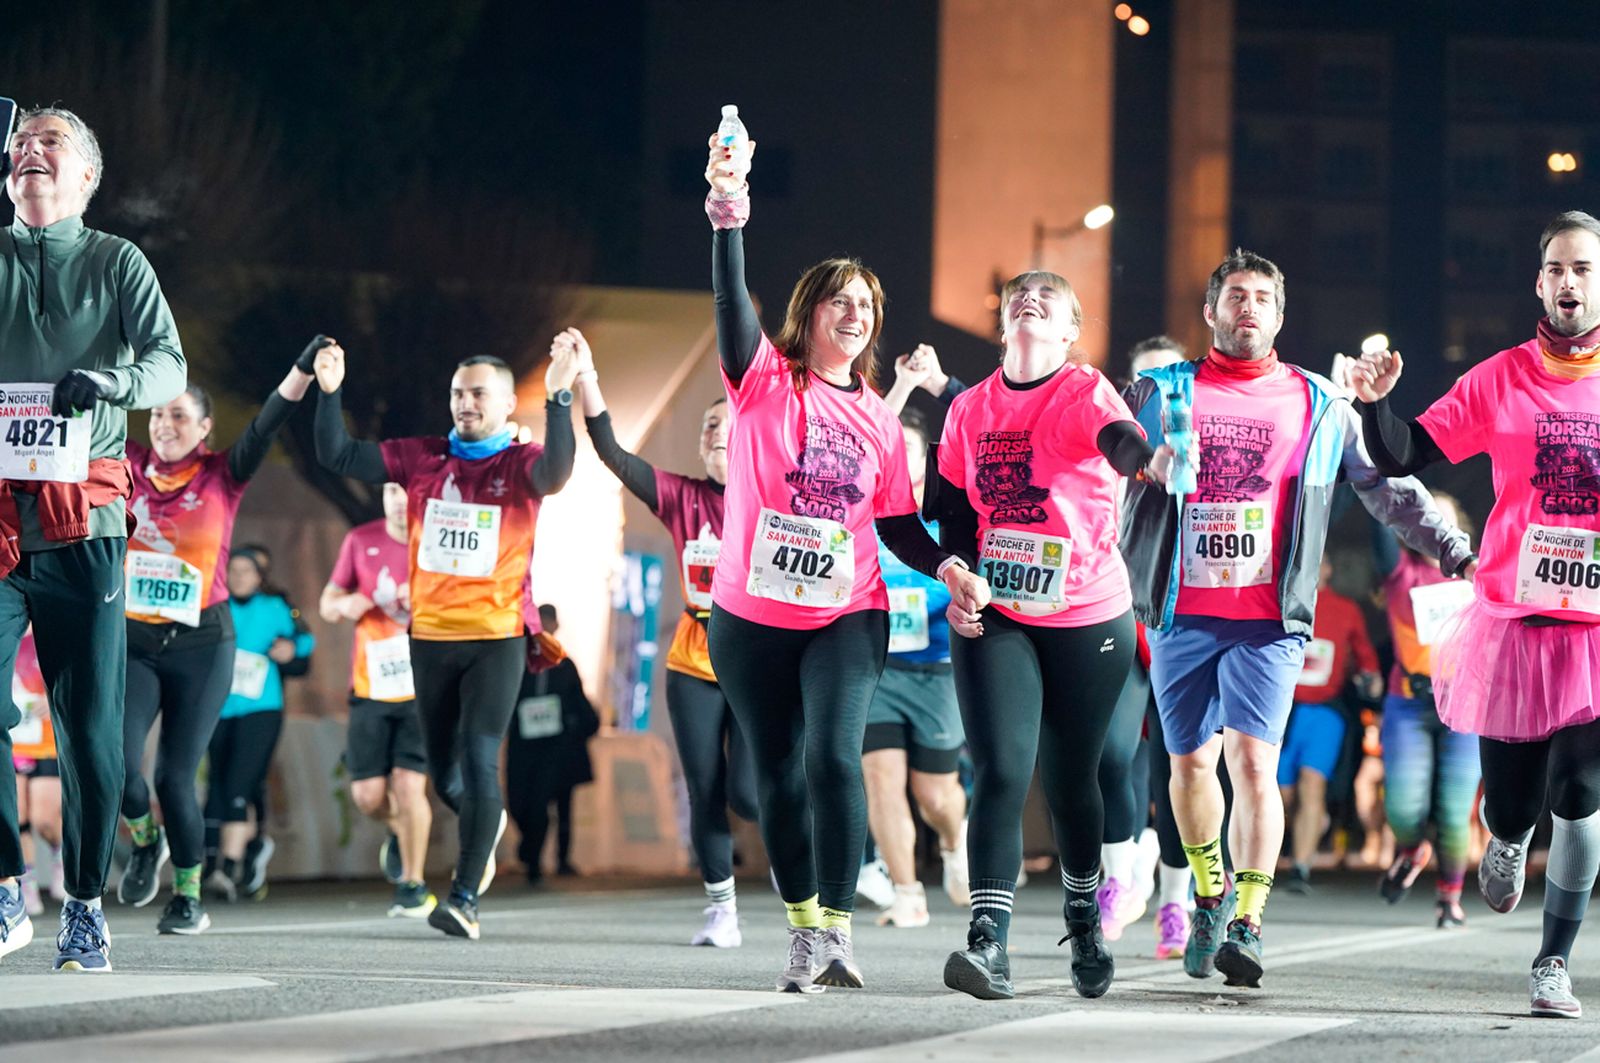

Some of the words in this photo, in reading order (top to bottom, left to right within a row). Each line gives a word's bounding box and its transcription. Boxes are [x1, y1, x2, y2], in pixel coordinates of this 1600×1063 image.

[8, 394, 38, 404] NOCHE
[0, 406, 16, 417] SAN
[1214, 416, 1274, 431] CONSEGUIDO
[1538, 422, 1600, 440] DORSA
[5, 418, 68, 447] 4821
[1201, 423, 1271, 446] DORSAL
[1212, 437, 1231, 447] SAN
[794, 496, 845, 522] 500€
[1545, 496, 1596, 513] 500€
[1200, 512, 1224, 520] NOCHE
[1226, 512, 1236, 520] DE
[781, 522, 810, 536] NOCHE
[811, 528, 822, 538] DE
[1192, 522, 1206, 532] SAN
[439, 528, 478, 550] 2116
[767, 531, 788, 542] SAN
[1544, 535, 1572, 546] NOCHE
[1574, 539, 1586, 548] DE
[995, 538, 1022, 550] NOCHE
[1024, 542, 1036, 552] DE
[1196, 534, 1255, 559] 4690
[1532, 544, 1550, 554] SAN
[772, 546, 834, 580] 4702
[984, 548, 1002, 560] SAN
[1003, 551, 1034, 564] ANTÓN
[984, 560, 1055, 594] 13907
[1535, 557, 1600, 590] 4906
